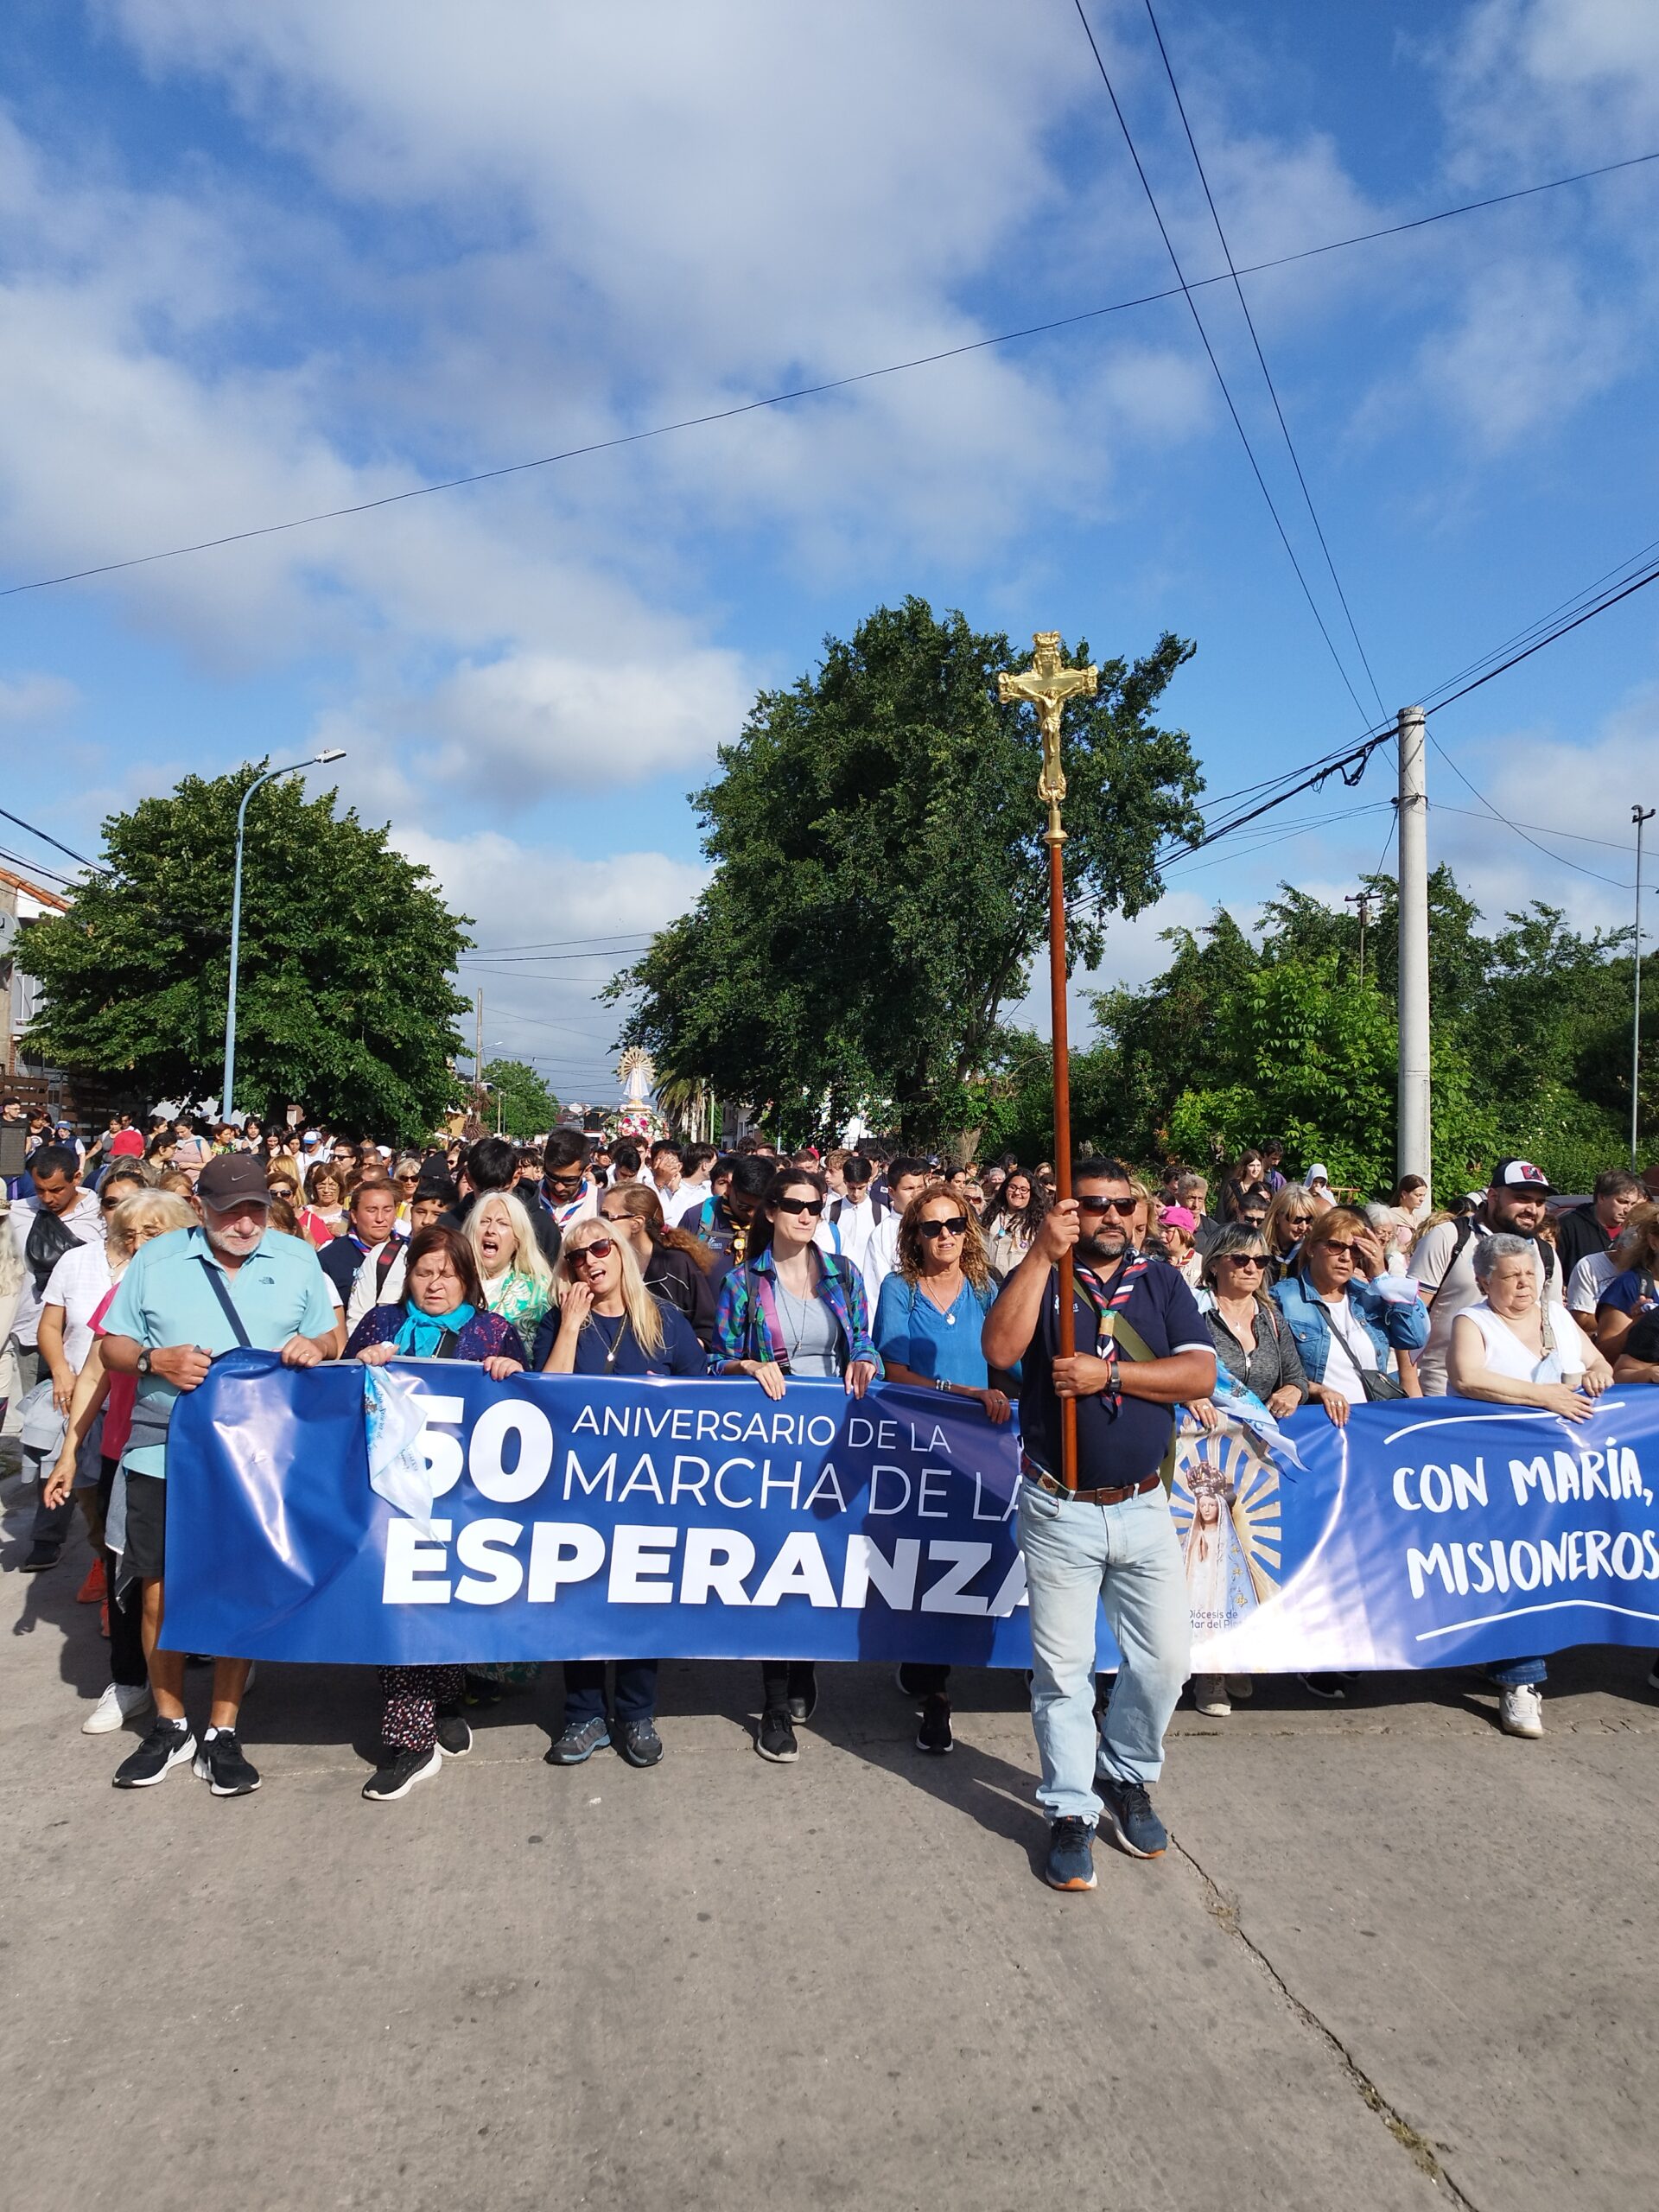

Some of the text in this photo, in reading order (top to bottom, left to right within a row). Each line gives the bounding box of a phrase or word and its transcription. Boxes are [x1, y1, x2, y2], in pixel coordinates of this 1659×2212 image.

[407, 1394, 554, 1503] 50
[571, 1405, 952, 1453] ANIVERSARIO DE LA
[563, 1449, 848, 1513] MARCHA
[868, 1465, 952, 1518] DE
[1392, 1436, 1654, 1513] CON MARÍA,
[1406, 1529, 1659, 1599] MISIONEROS
[1206, 1619, 1222, 1629] del
[1225, 1609, 1238, 1619] de
